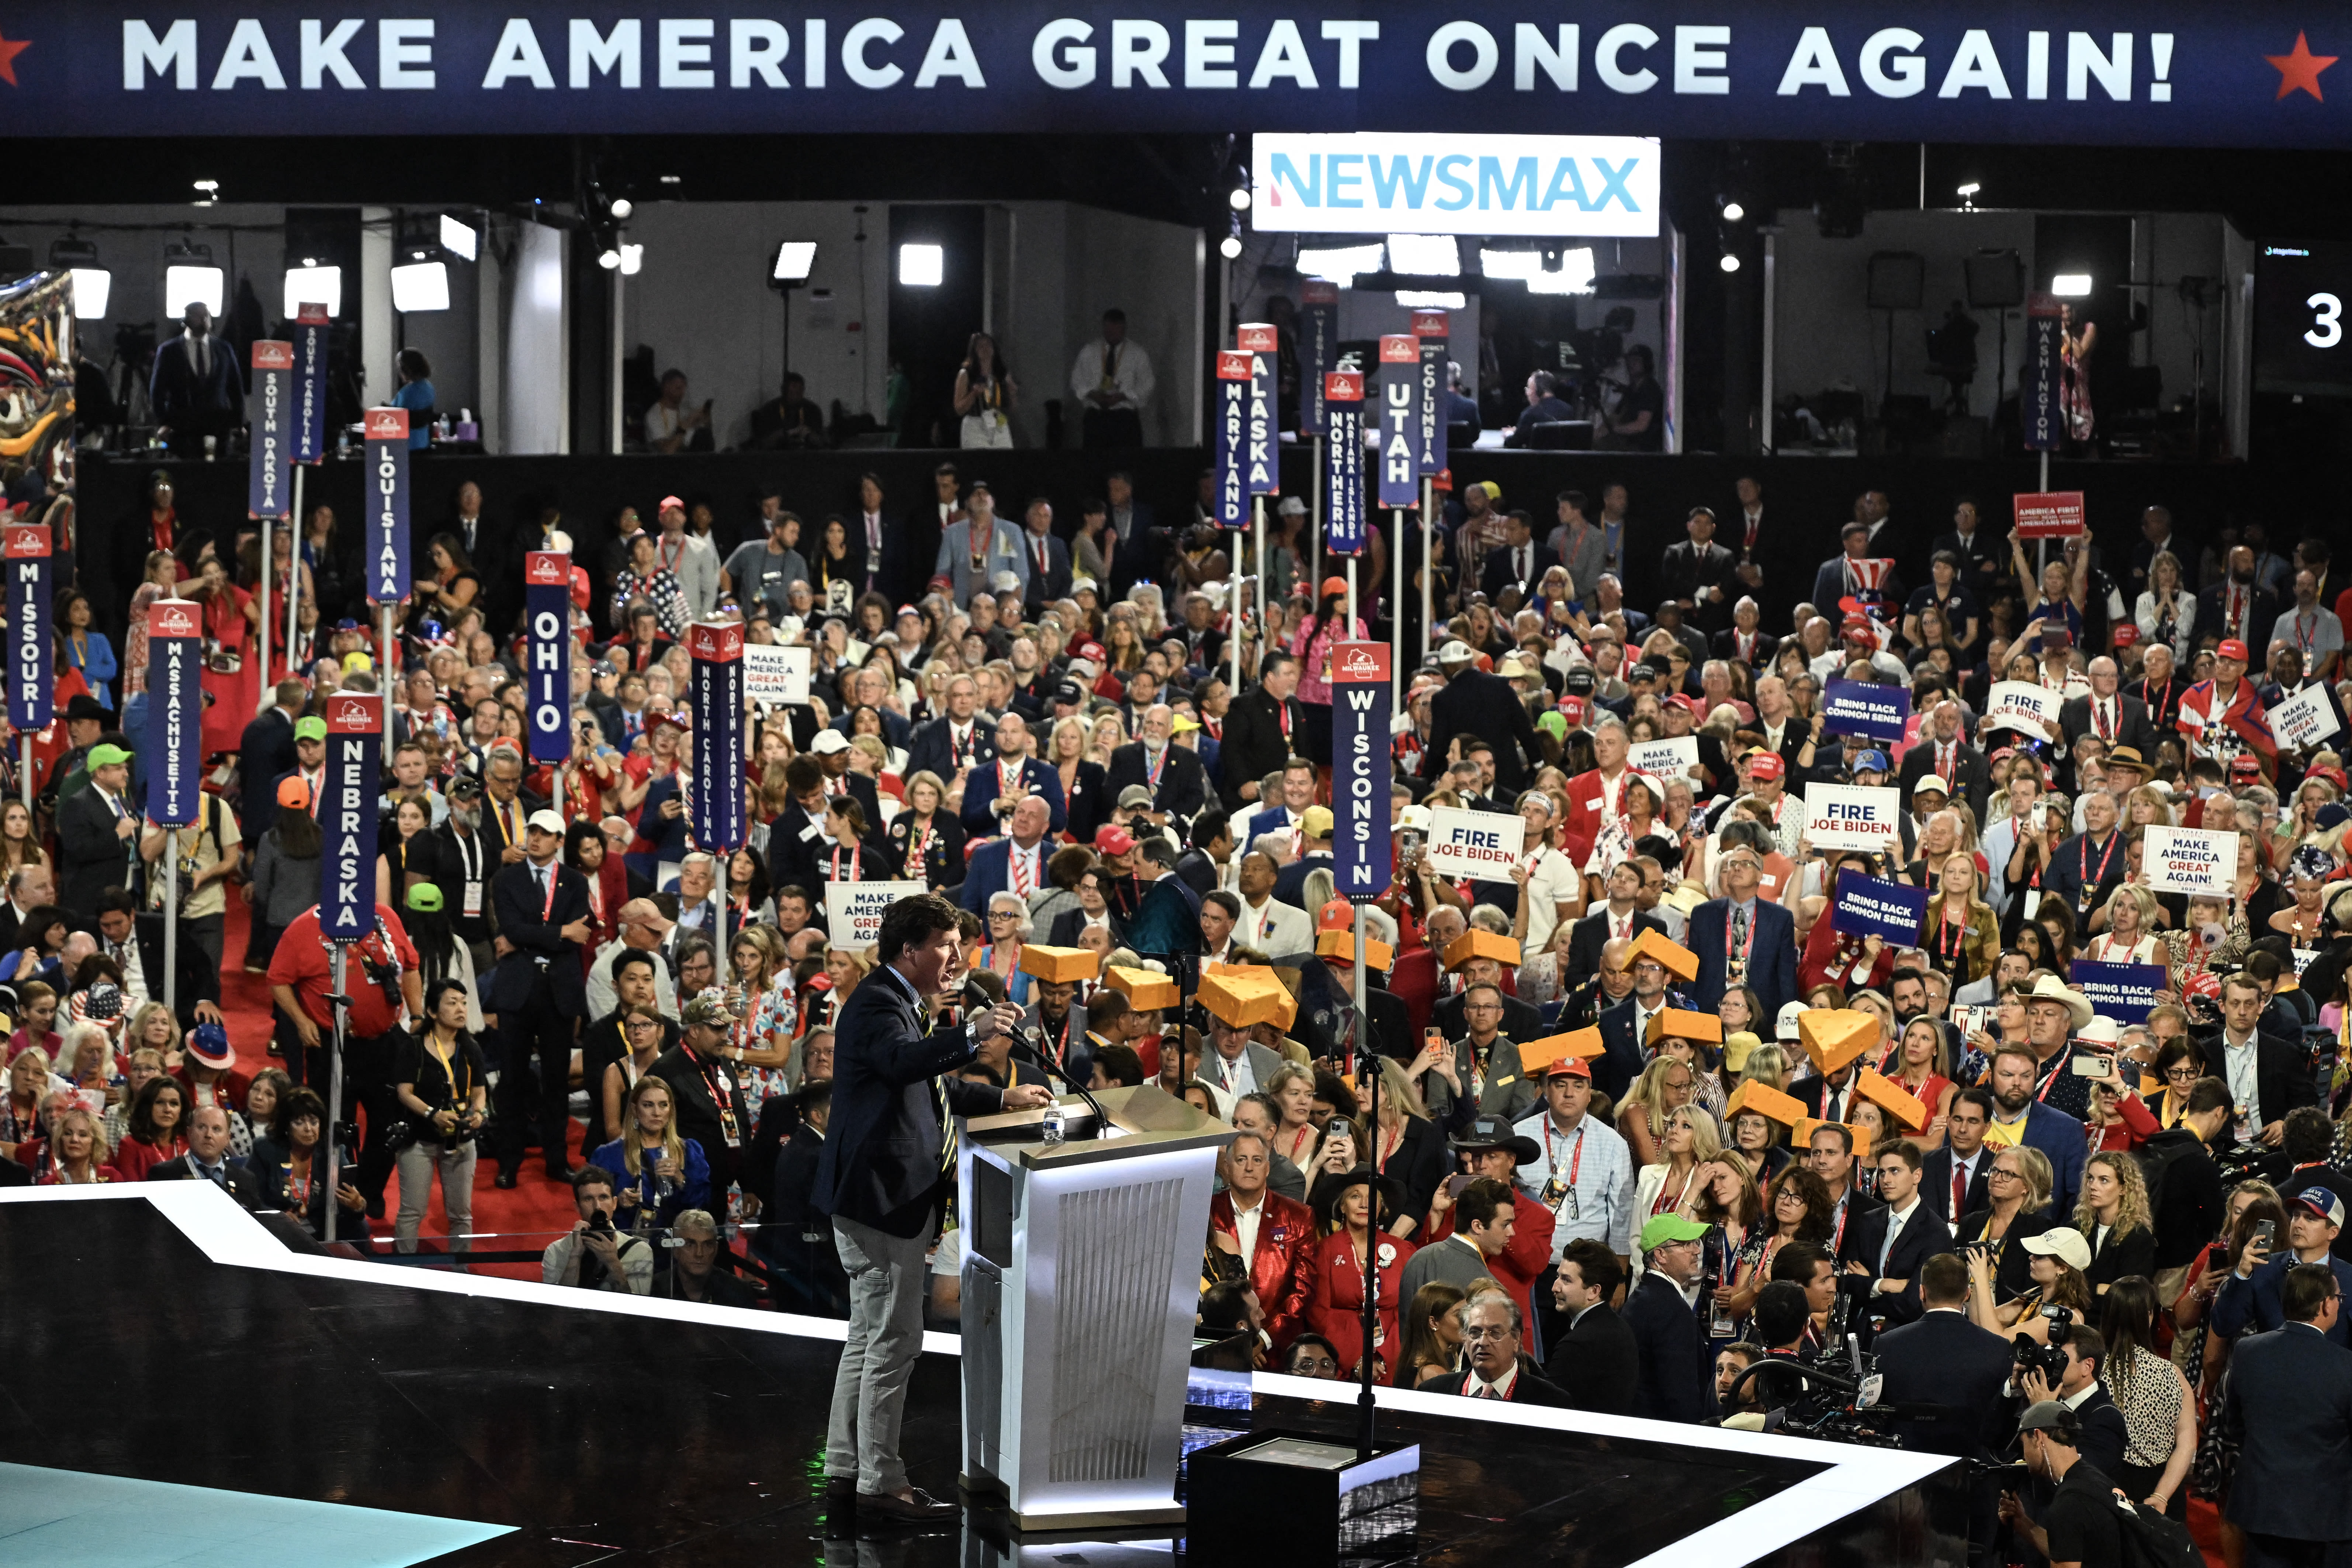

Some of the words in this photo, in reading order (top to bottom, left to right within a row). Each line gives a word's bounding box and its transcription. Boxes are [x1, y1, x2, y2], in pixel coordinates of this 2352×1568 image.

[124, 19, 435, 89] MAKE
[482, 18, 986, 89] AMERICA
[1032, 18, 1379, 89] GREAT
[1427, 21, 1730, 94] ONCE
[1777, 27, 2173, 101] AGAIN!
[1271, 153, 1642, 212] NEWSMAX
[2304, 293, 2342, 347] 3
[305, 327, 316, 374] SOUTH
[2037, 321, 2051, 440] WASHINGTON
[265, 373, 278, 432] SOUTH
[1421, 364, 1435, 464] COLUMBIA
[301, 379, 313, 456] CAROLINA
[1250, 356, 1269, 483] ALASKA
[1346, 412, 1355, 474] MARIANA
[1386, 383, 1411, 483] UTAH
[1225, 383, 1242, 520] MARYLAND
[263, 437, 276, 508] DAKOTA
[1330, 412, 1344, 538] NORTHERN
[379, 445, 396, 595] LOUISIANA
[1347, 478, 1355, 540] ISLANDS
[19, 563, 40, 721] MISSOURI
[751, 654, 784, 664] MAKE
[535, 612, 561, 733] OHIO
[748, 674, 786, 684] GREAT
[702, 665, 710, 732] NORTH
[747, 683, 787, 693] AGAIN!
[1835, 698, 1867, 710] BRING
[1868, 703, 1897, 715] BACK
[2004, 694, 2042, 712] FIRE
[2282, 700, 2308, 719] MAKE
[1826, 707, 1870, 720] COMMON
[1871, 713, 1902, 724] SENSE
[2280, 705, 2318, 732] AMERICA
[2288, 716, 2315, 737] GREAT
[167, 642, 182, 817] MASSACHUSETTS
[1636, 757, 1684, 769] AMERICA
[1643, 748, 1673, 759] MAKE
[1652, 767, 1677, 777] REAT
[703, 738, 712, 843] CAROLINA
[730, 737, 738, 842] CAROLINA
[1347, 690, 1375, 884] WISCONSIN
[1828, 803, 1875, 821] FIRE
[336, 740, 363, 927] NEBRASKA
[1452, 828, 1500, 848] FIRE
[1810, 819, 1839, 831] JOE
[1845, 821, 1892, 834] BIDEN
[1433, 843, 1463, 857] JOE
[1467, 847, 1515, 863] BIDEN
[2161, 849, 2220, 863] AMERICA
[2173, 838, 2210, 851] MAKE
[2166, 872, 2212, 884] AGAIN!
[2168, 861, 2211, 873] GREAT
[856, 893, 895, 903] MAKE
[1847, 892, 1879, 910] BRING
[1881, 901, 1912, 917] BACK
[845, 906, 883, 915] AMER
[1839, 901, 1881, 921] COMMON
[1883, 913, 1918, 929] SENSE
[853, 918, 881, 928] GRE
[853, 930, 879, 940] AGA
[2083, 993, 2124, 1004] OMMON
[2084, 982, 2119, 994] BRING
[2121, 986, 2152, 996] BACK
[2301, 1193, 2323, 1205] AMERICA
[1865, 1377, 1879, 1387] NETWORK
